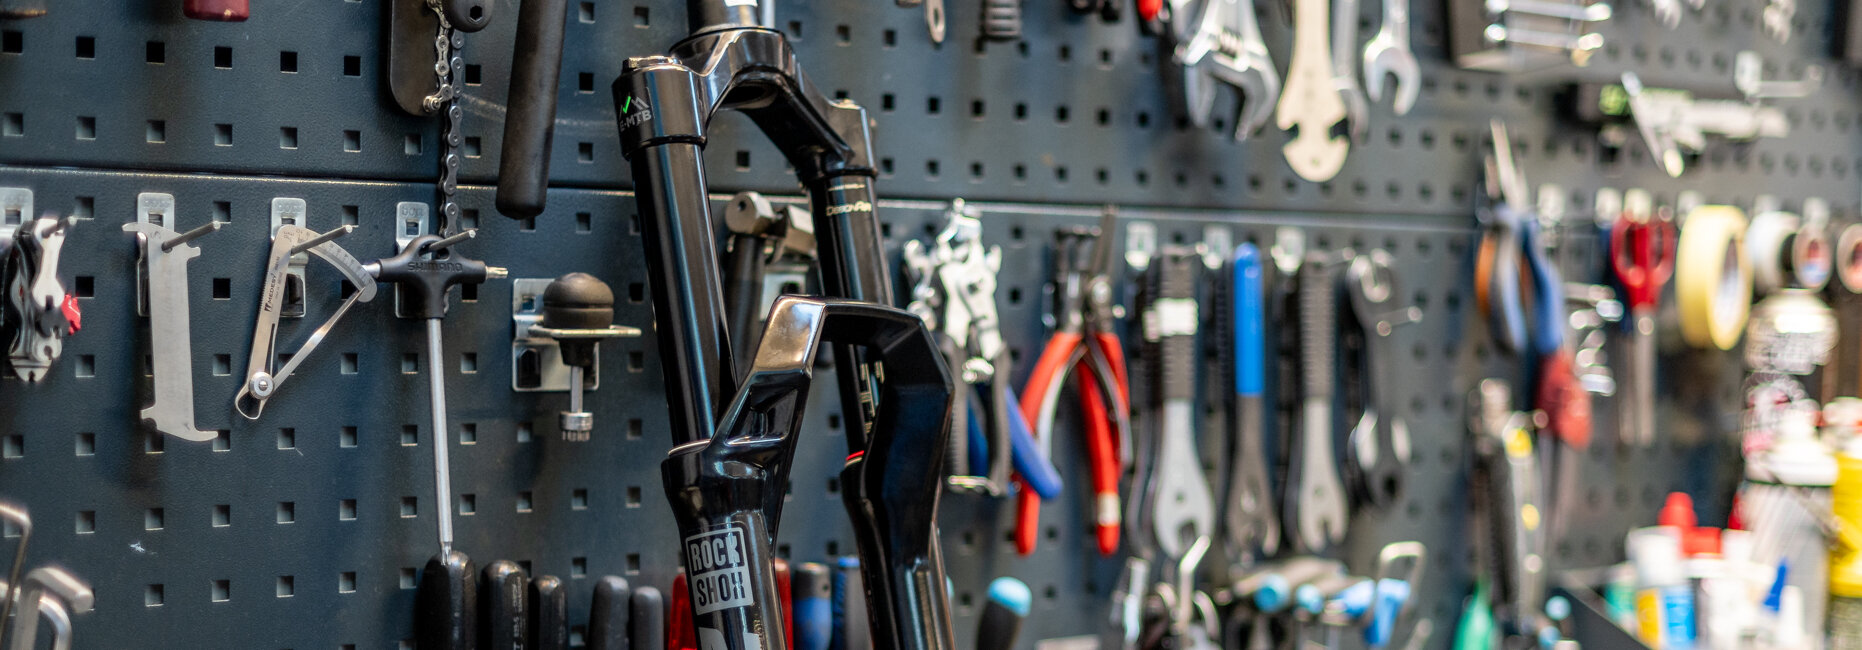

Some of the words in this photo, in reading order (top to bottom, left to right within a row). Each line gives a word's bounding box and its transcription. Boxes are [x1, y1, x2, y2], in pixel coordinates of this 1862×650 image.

[407, 261, 463, 273] SHIMANO
[690, 534, 740, 572] ROCK
[696, 571, 746, 607] SHOX
